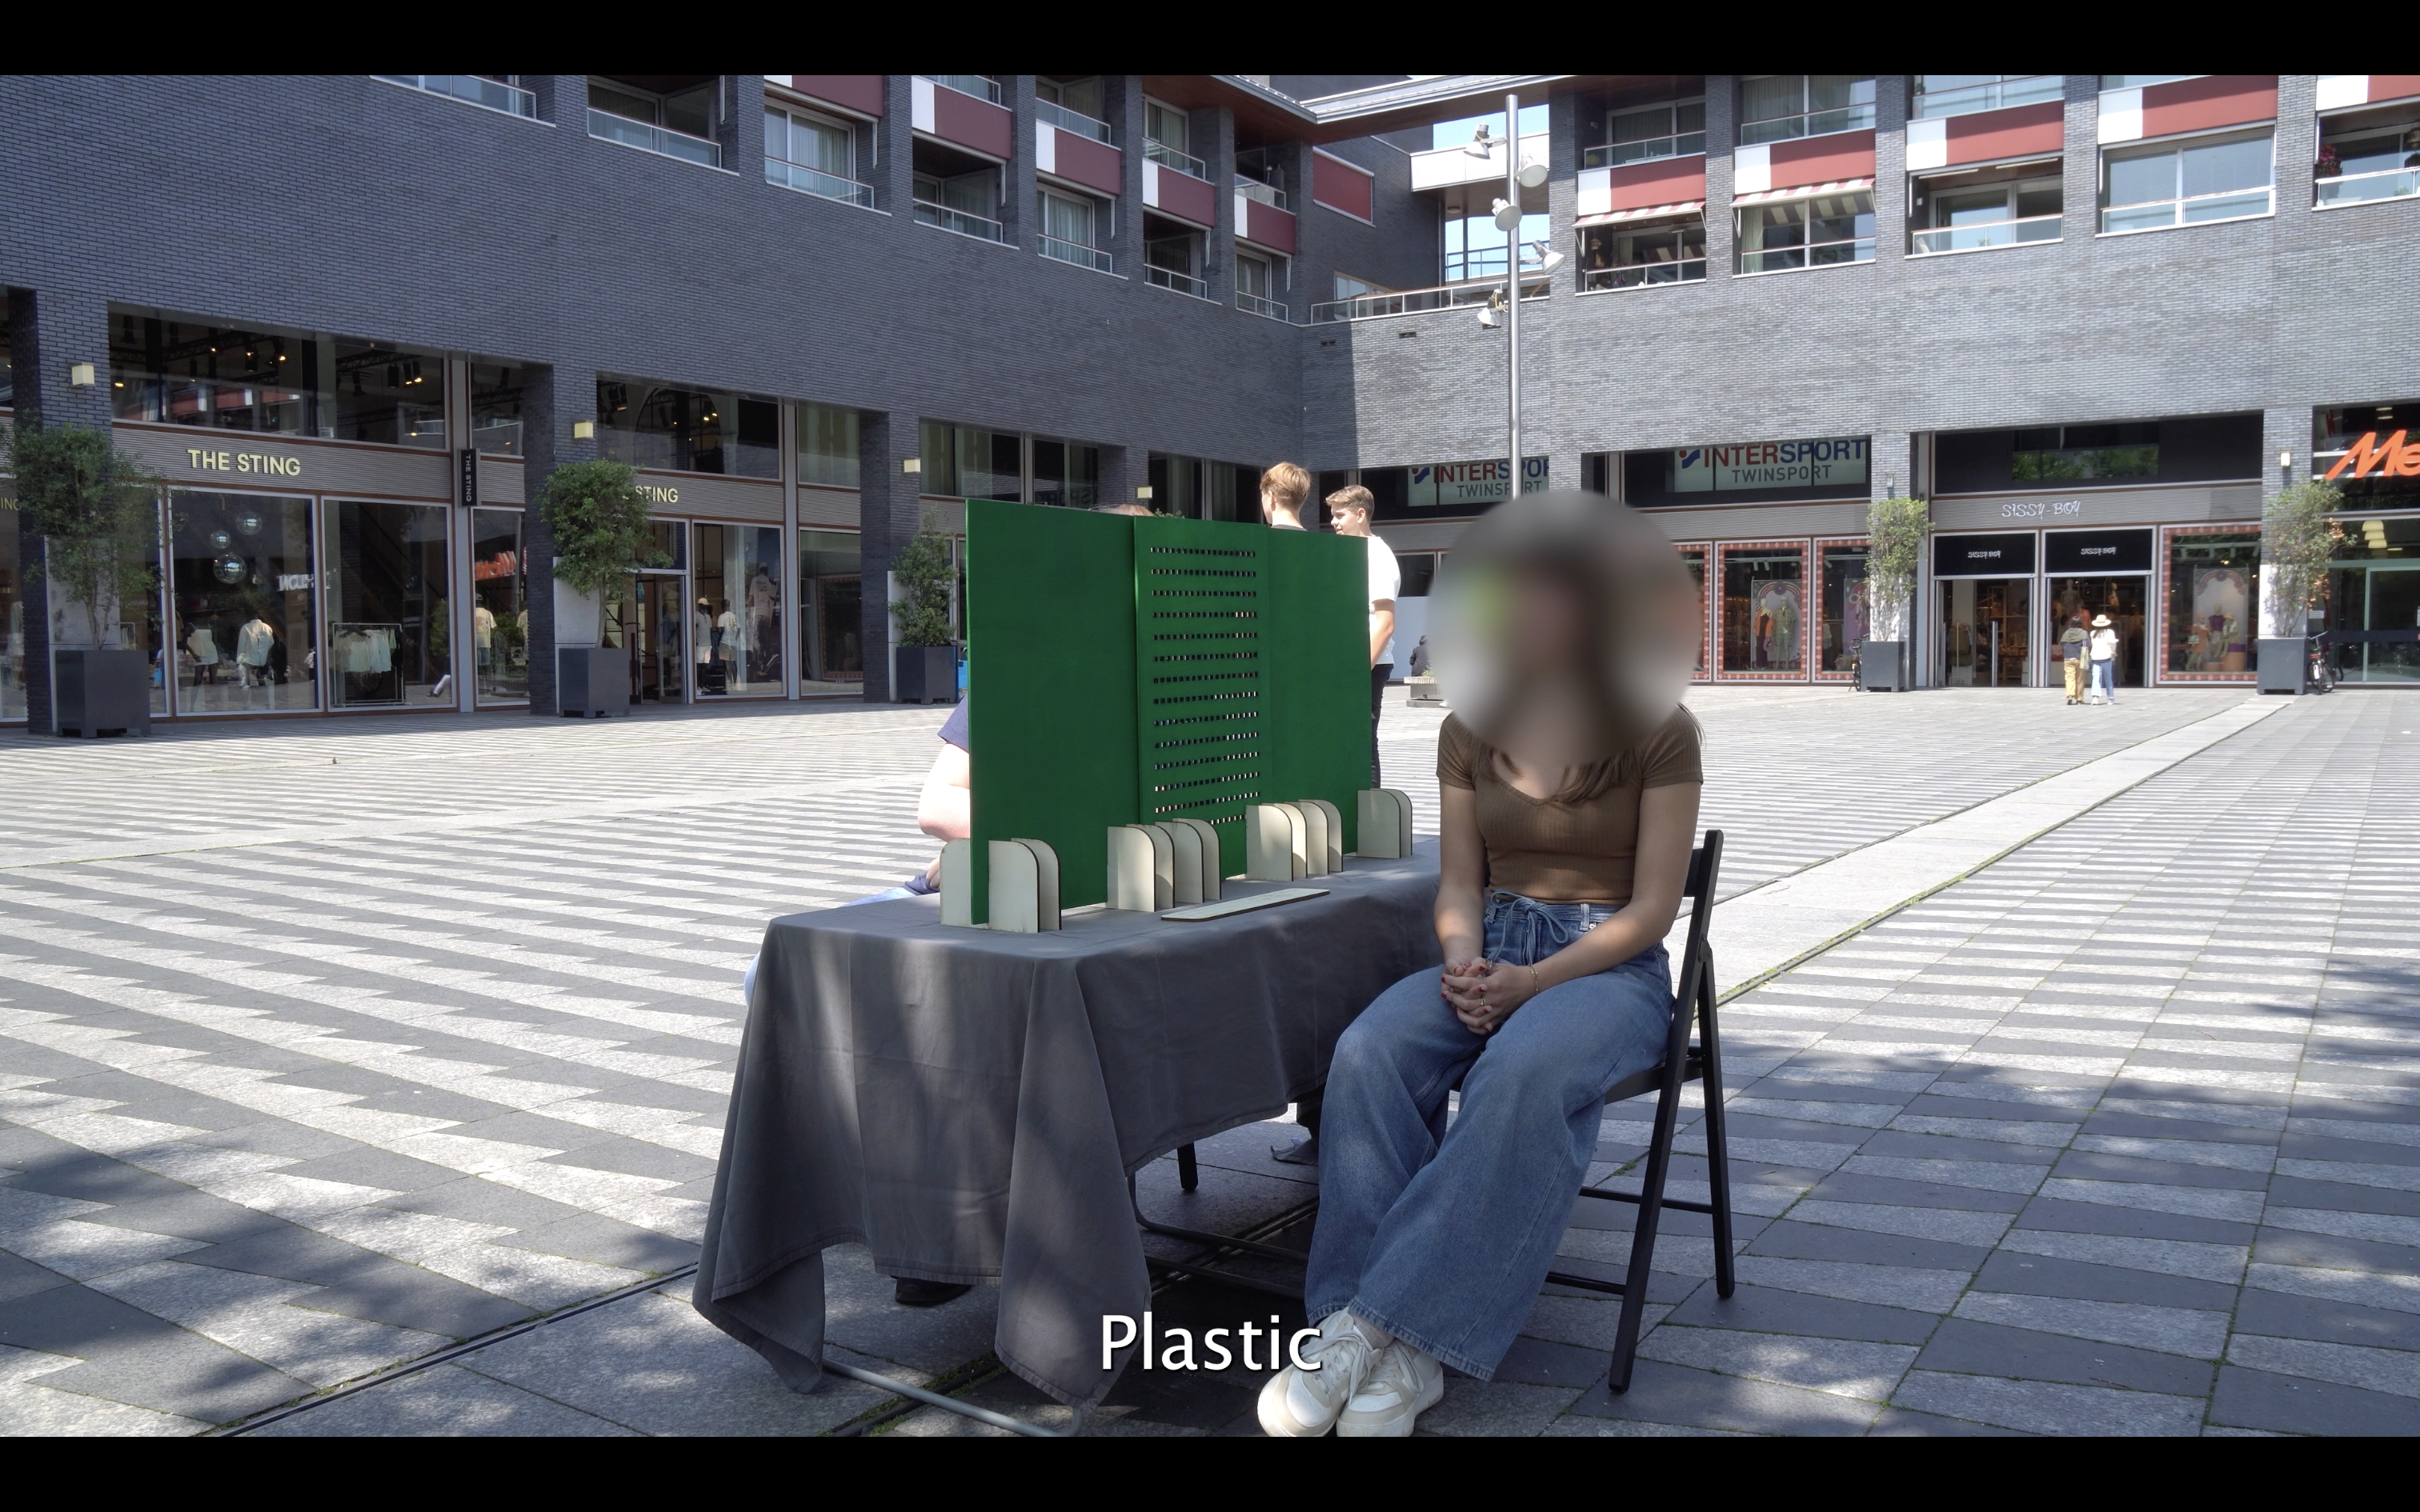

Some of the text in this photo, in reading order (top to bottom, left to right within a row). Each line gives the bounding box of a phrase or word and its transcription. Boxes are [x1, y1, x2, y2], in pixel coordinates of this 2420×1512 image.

[187, 449, 301, 476] THE STING
[1704, 440, 1865, 468] INTERSPORT
[1732, 465, 1832, 483] TWINSPORT
[1457, 481, 1542, 498] TWINSRT
